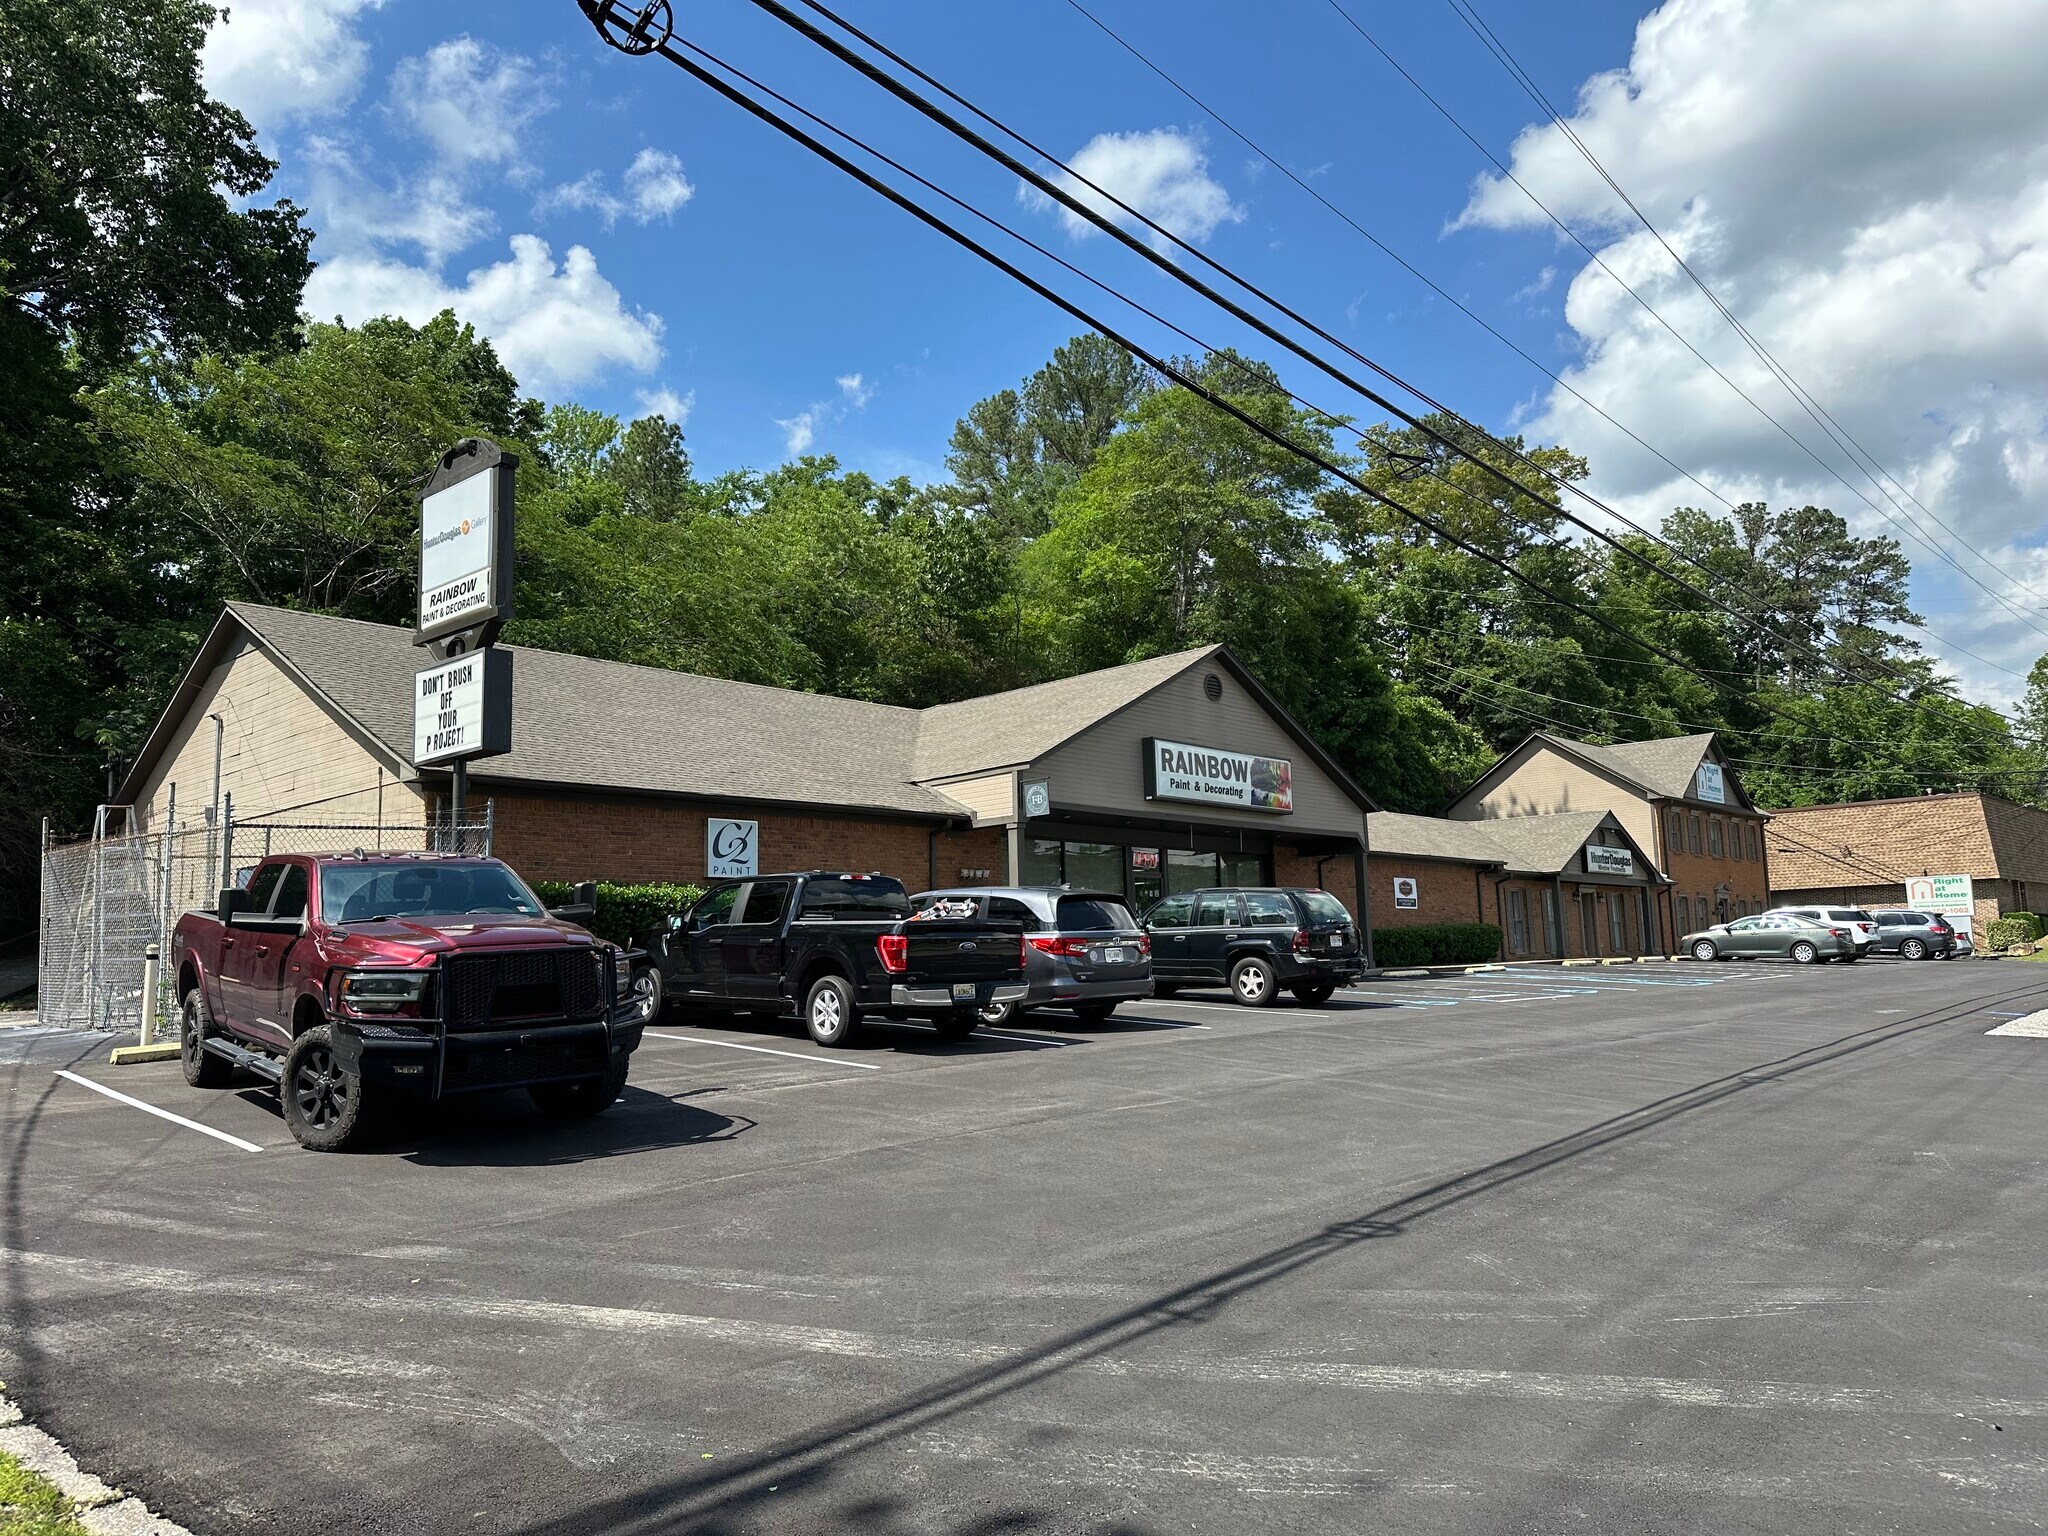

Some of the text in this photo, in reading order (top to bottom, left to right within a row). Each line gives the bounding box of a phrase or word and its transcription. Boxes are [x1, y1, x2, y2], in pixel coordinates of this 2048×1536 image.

[430, 577, 477, 607] RAINBOW
[422, 591, 485, 625] PAINT & DECORATING
[423, 664, 472, 696] DON'T BRUSH
[441, 691, 453, 710] OFF
[438, 709, 457, 730] YOUR
[1161, 747, 1248, 783] RAINBOW
[1170, 778, 1244, 799] Paint & Decorating
[1590, 851, 1632, 868] HunterDouglas
[713, 866, 752, 875] PAINT
[1933, 877, 1964, 886] Right
